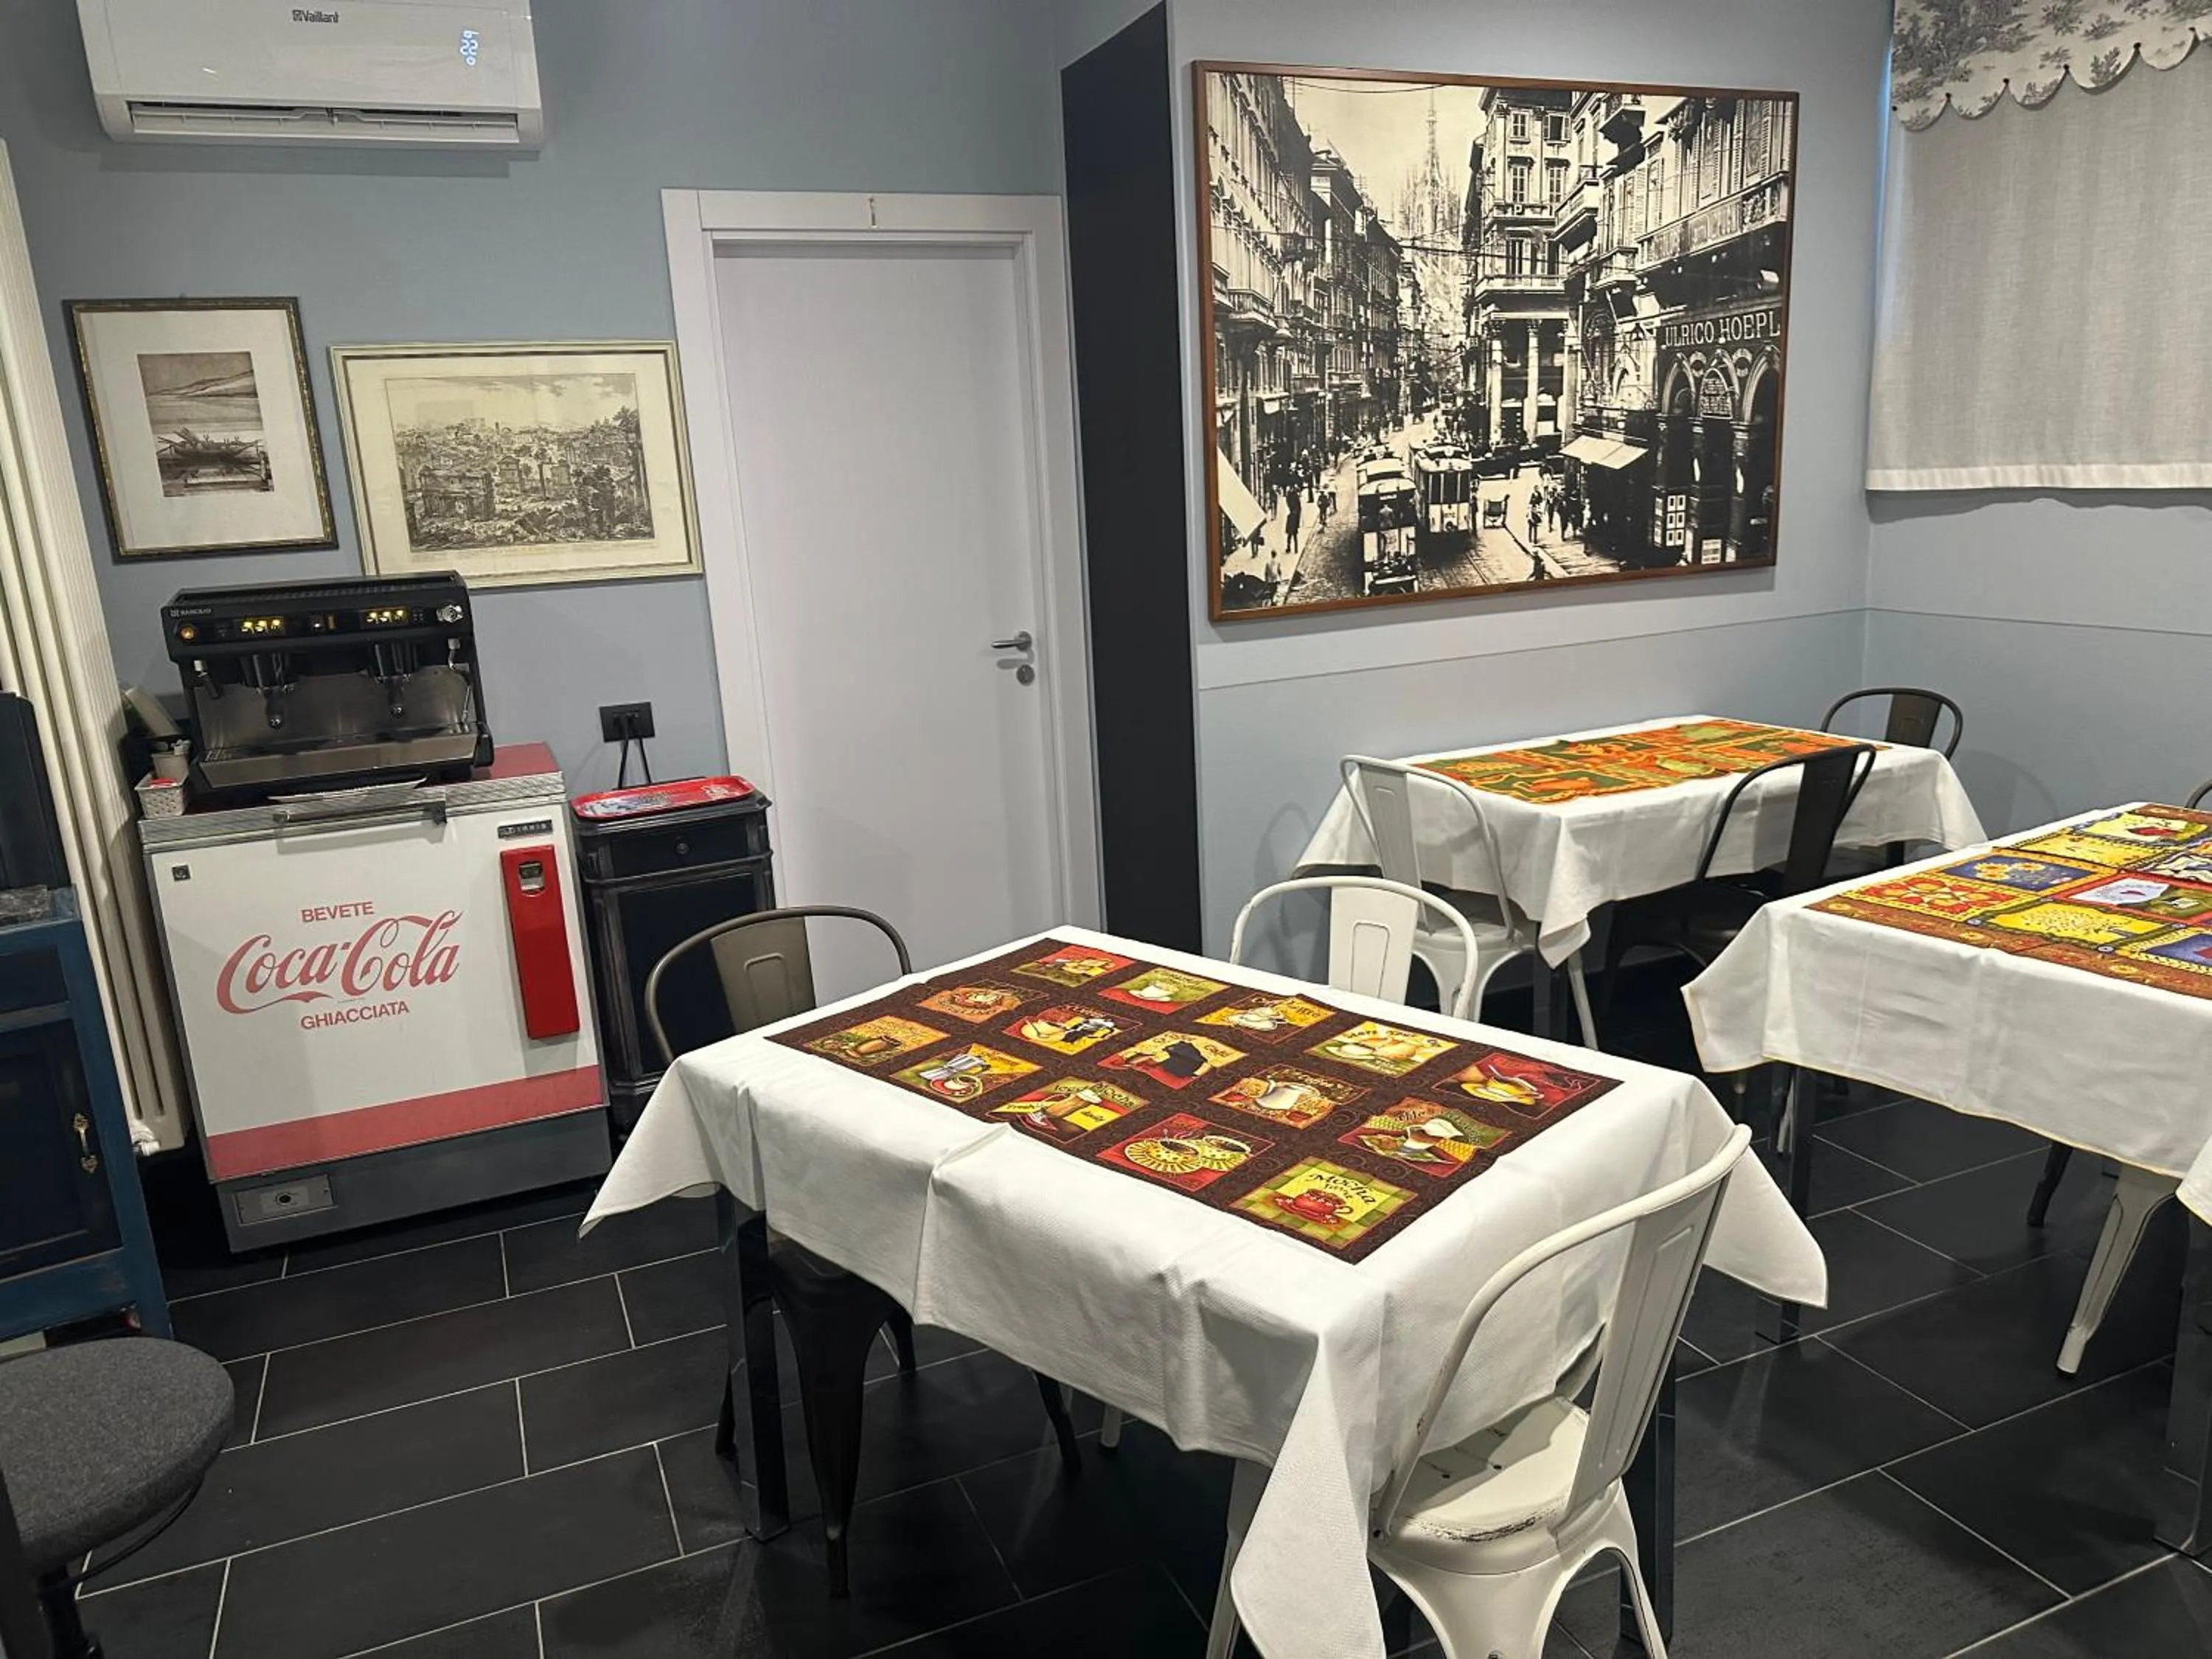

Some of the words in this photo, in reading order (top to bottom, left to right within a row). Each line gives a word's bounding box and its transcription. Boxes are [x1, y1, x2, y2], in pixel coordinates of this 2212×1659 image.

[1666, 321, 1714, 347] ULRICO
[1719, 310, 1781, 341] HOEPL
[301, 901, 375, 922] BEVETE
[217, 910, 463, 1014] Coca-Cola
[300, 1001, 409, 1030] GHIACCIATA
[1310, 1173, 1377, 1205] Mocha
